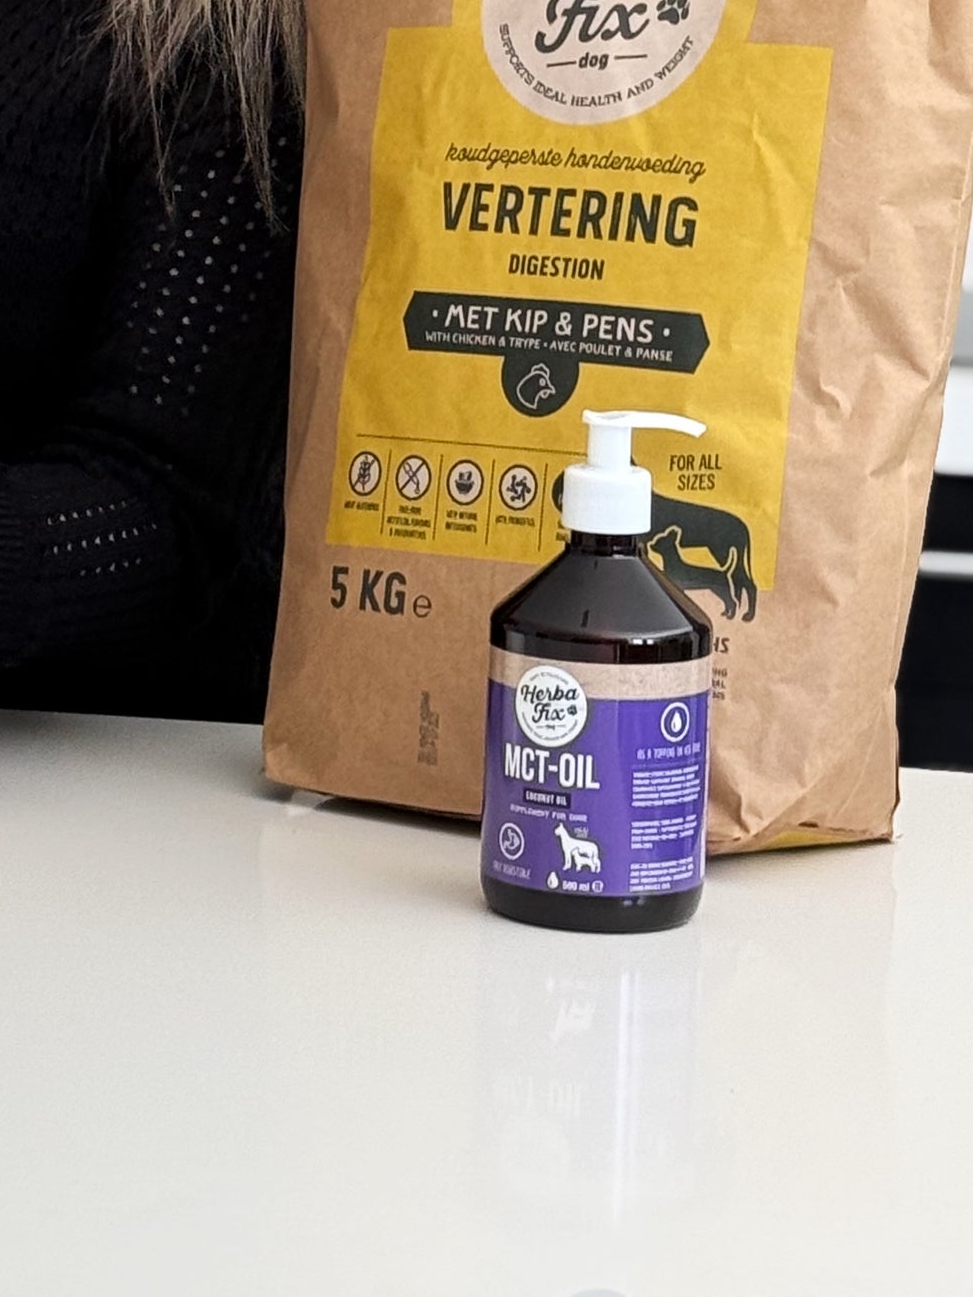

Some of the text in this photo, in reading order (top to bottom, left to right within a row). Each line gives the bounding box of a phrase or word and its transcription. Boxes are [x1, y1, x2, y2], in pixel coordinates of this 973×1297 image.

[499, 23, 694, 108] SUPPORTS IDEAL HEALTH AND WEIGHT
[578, 52, 609, 70] dog
[444, 142, 706, 184] koudgeperste hondenvoeding
[442, 181, 700, 248] VERTERING
[508, 253, 606, 280] DIGESTION
[444, 304, 655, 343] MET KIP & PENS
[425, 330, 450, 343] WITH
[452, 332, 496, 346] CHICKEN
[498, 336, 505, 347] &
[549, 340, 576, 352] AVEC
[579, 342, 621, 356] POULET
[624, 347, 632, 358] &
[635, 347, 674, 362] PANSE
[669, 454, 722, 471] FOR ALL
[677, 473, 716, 491] SIZES
[330, 565, 349, 609] 5
[359, 568, 407, 616] KG
[520, 684, 580, 705] Herba
[531, 702, 565, 723] Fix
[504, 742, 601, 789] MCT-OIL
